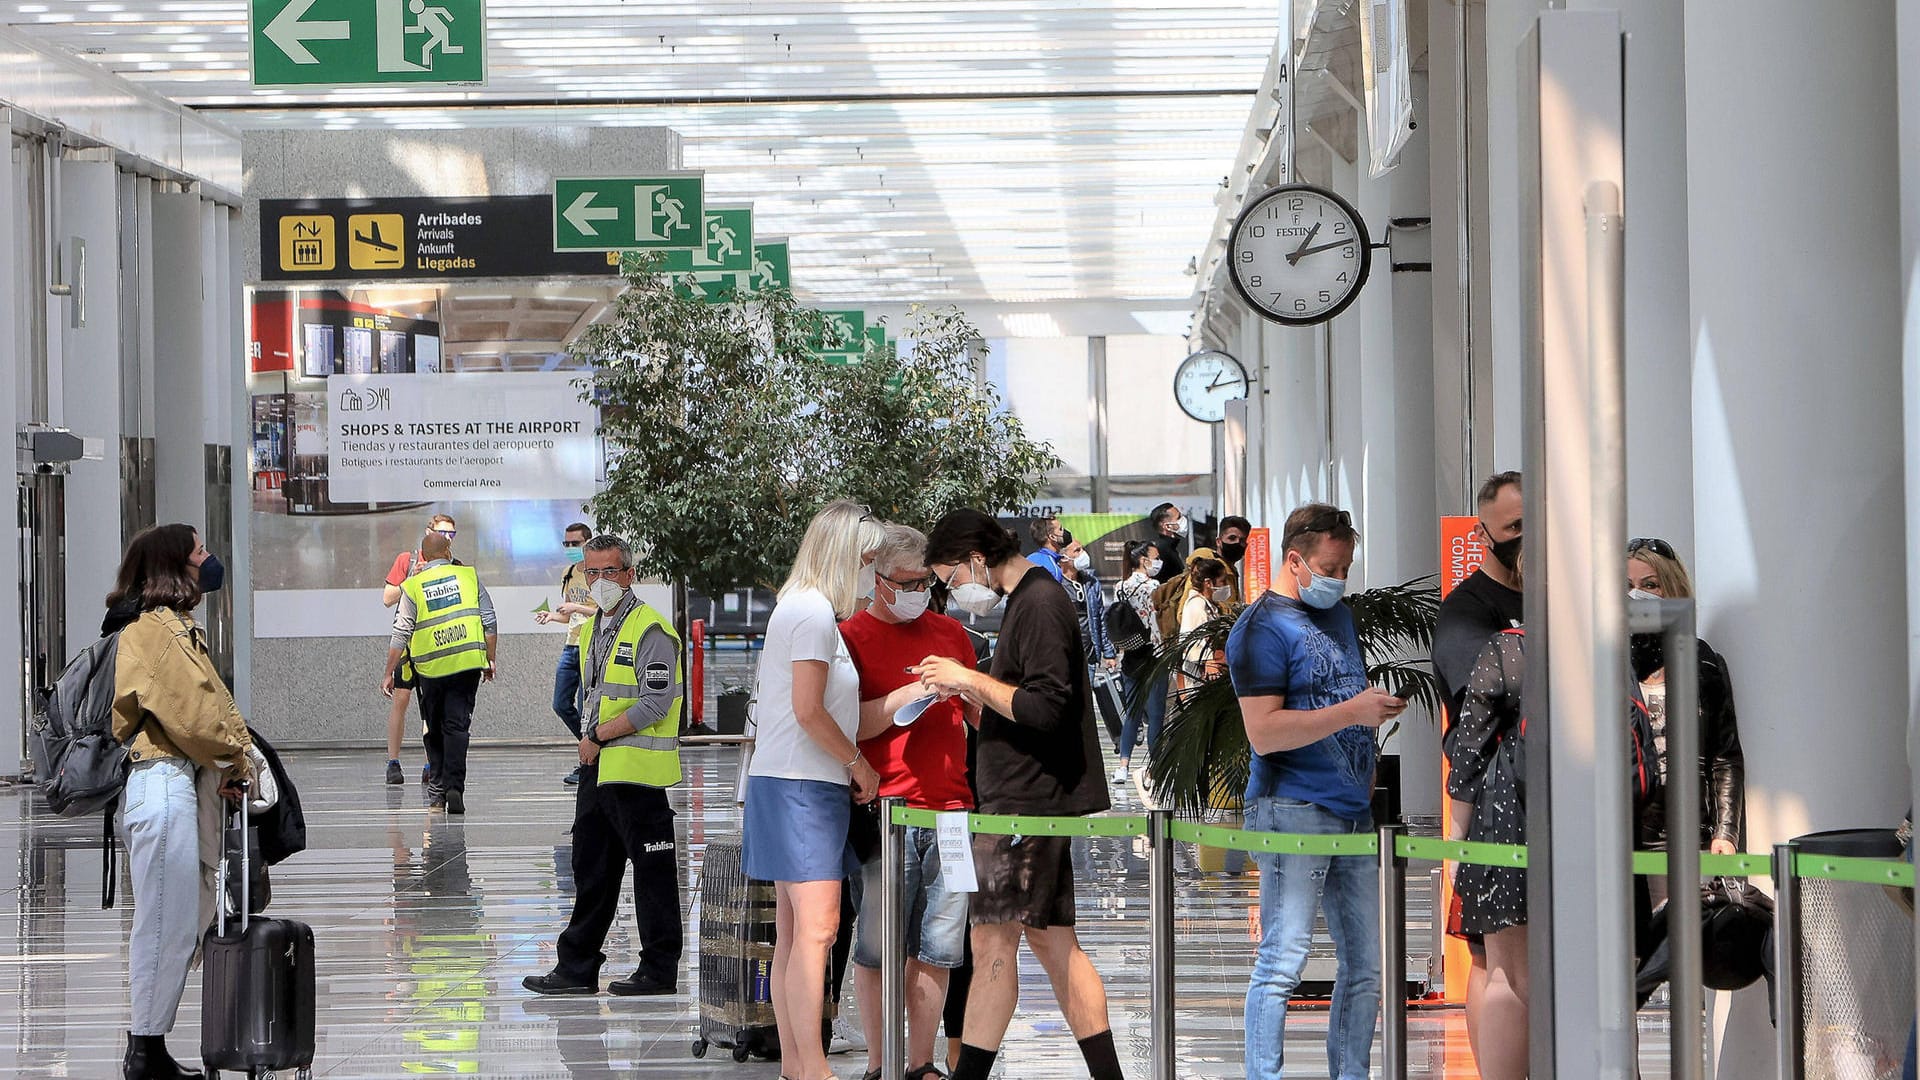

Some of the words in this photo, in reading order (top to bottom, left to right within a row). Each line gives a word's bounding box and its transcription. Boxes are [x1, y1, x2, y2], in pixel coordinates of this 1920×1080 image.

[1288, 198, 1304, 211] 12
[1319, 204, 1323, 217] 1
[417, 212, 482, 226] Arribades
[1267, 207, 1278, 219] 11
[417, 227, 455, 240] Arrivals
[1249, 226, 1265, 238] 10
[1334, 222, 1346, 234] 2
[417, 242, 455, 254] Ankunft
[1342, 246, 1355, 259] 3
[1241, 250, 1254, 263] 9
[417, 256, 476, 271] Llegadas
[1250, 275, 1262, 287] 8
[1335, 271, 1347, 283] 4
[1270, 292, 1281, 304] 7
[1318, 290, 1331, 303] 5
[1294, 298, 1306, 312] 6
[341, 423, 389, 436] SHOPS
[394, 423, 404, 435] &
[408, 422, 460, 435] TASTES
[465, 422, 482, 434] AT
[486, 422, 514, 434] THE
[518, 421, 581, 434] AIRPORT
[342, 441, 386, 452] Tiendas
[389, 443, 396, 453] y
[399, 440, 469, 451] restaurantes
[472, 440, 489, 450] del
[493, 440, 554, 451] aeropuerto
[341, 458, 383, 468] Botigues
[390, 457, 443, 466] restaurants
[446, 456, 457, 465] de
[459, 456, 504, 466] l'aeroport
[423, 478, 477, 488] Commercial
[479, 478, 501, 487] Area
[1257, 534, 1266, 560] CHECK
[1466, 531, 1483, 576] CHEC
[1451, 536, 1465, 589] COMPR
[424, 584, 459, 599] Trablisa
[434, 624, 467, 647] SEGURIDAD
[643, 841, 674, 852] Trablisa
